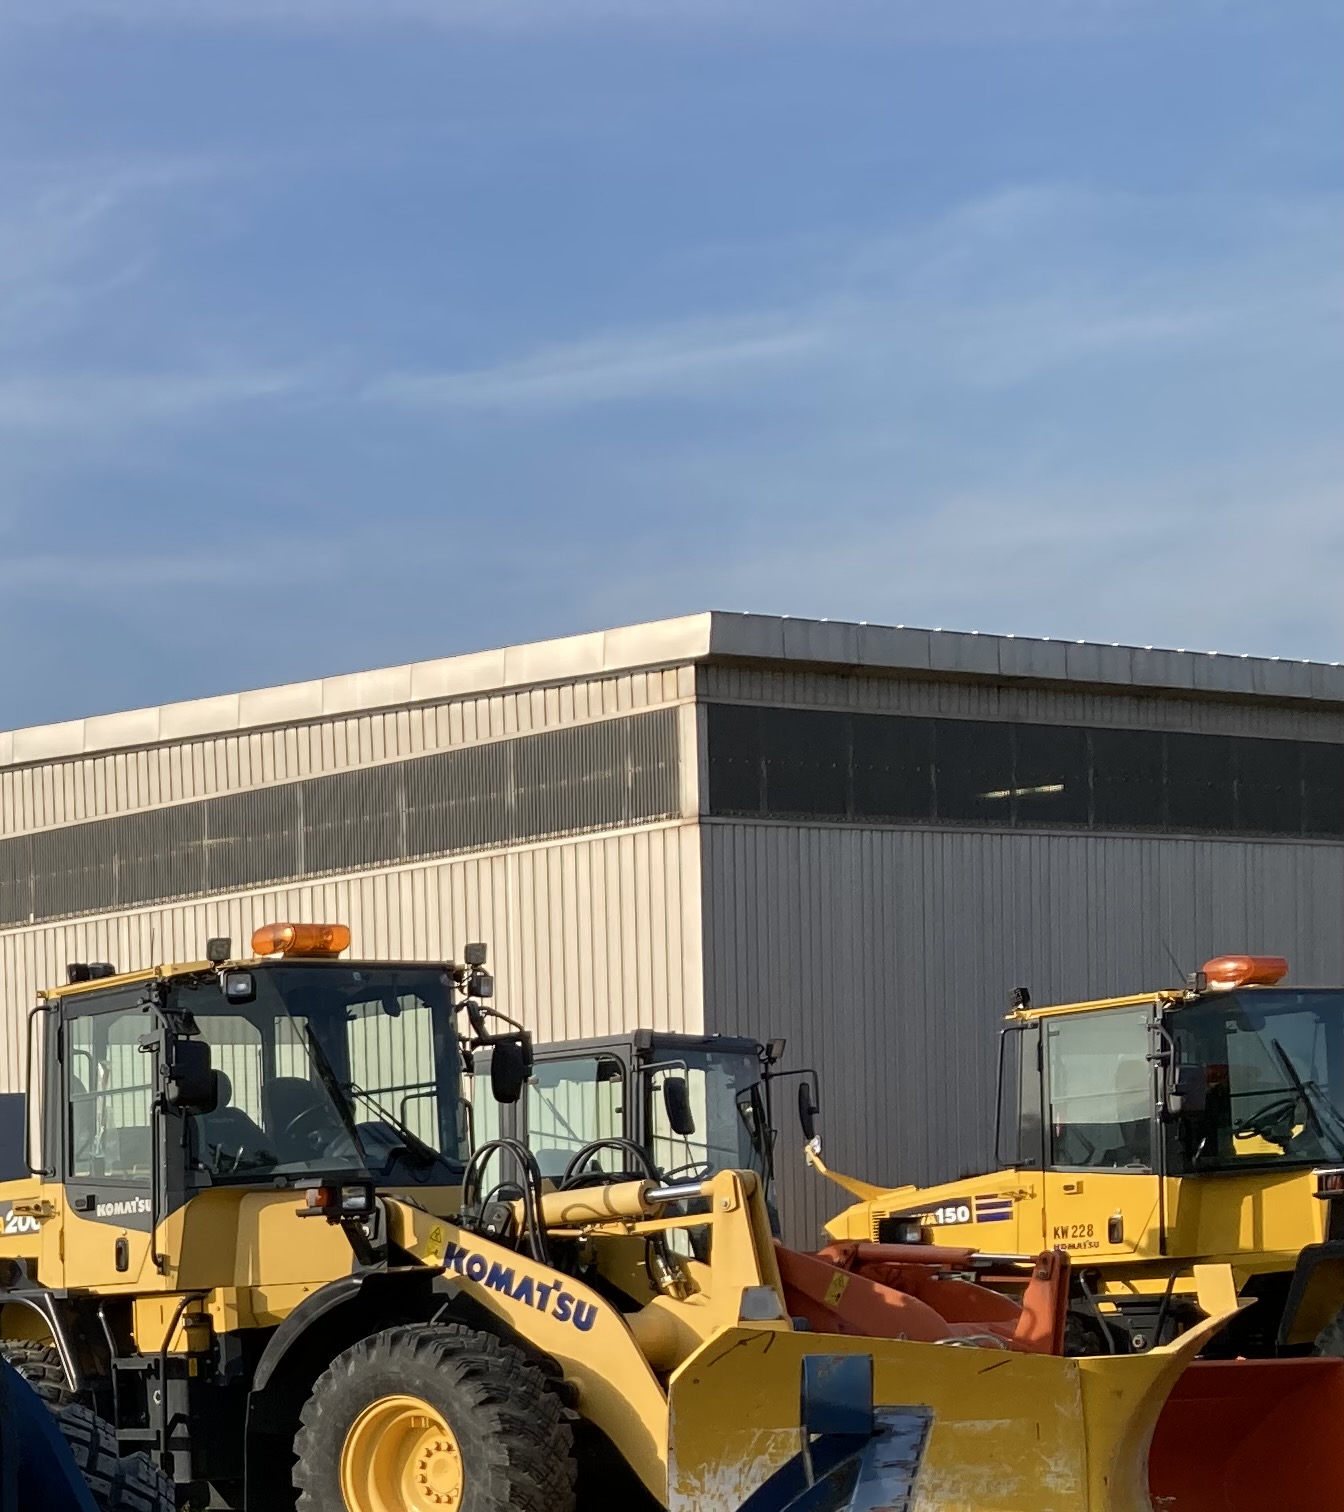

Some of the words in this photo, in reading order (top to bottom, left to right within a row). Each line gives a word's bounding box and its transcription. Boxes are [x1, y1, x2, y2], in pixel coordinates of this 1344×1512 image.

[96, 1196, 152, 1217] KOMATSU
[1053, 1225, 1069, 1240] KW
[1071, 1223, 1094, 1238] 228
[444, 1241, 599, 1332] KOMATSU
